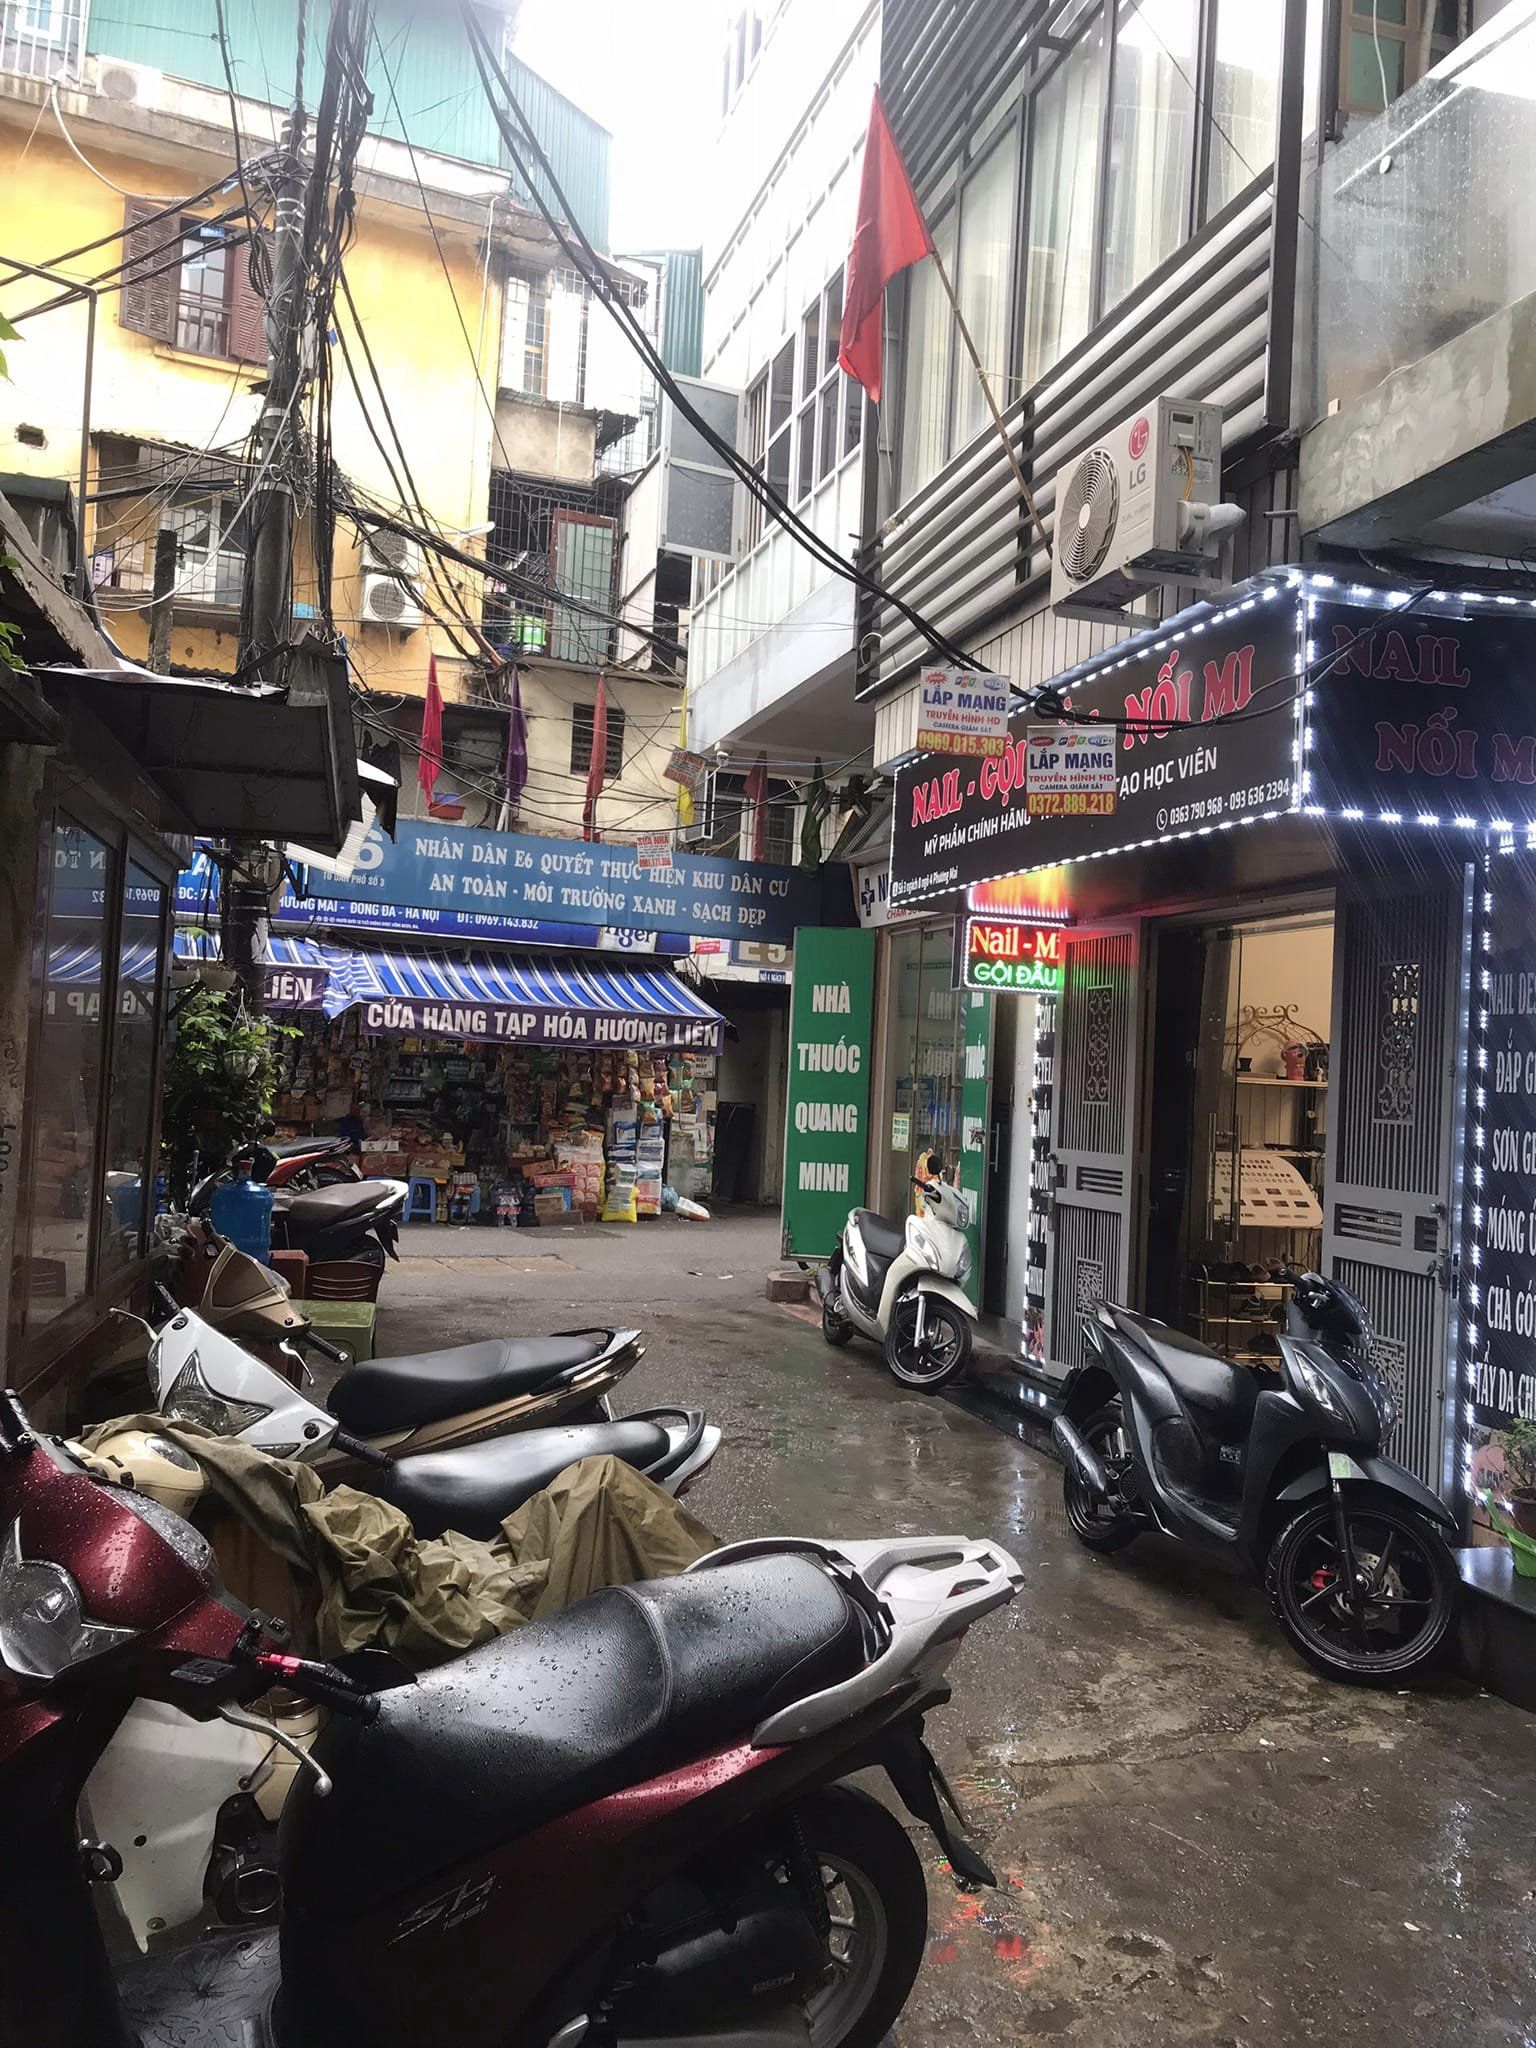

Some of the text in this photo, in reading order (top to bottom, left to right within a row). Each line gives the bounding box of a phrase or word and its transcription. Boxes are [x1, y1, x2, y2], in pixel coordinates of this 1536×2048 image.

[1129, 463, 1146, 490] LG
[1331, 624, 1471, 688] NAIL
[923, 685, 1006, 712] LẮP MẠNG
[911, 768, 964, 828] NAIL
[979, 732, 1028, 806] GỘI
[1122, 650, 1193, 750] NỐI
[1201, 644, 1255, 722] MI
[933, 721, 959, 730] CAMERA
[988, 716, 1000, 726] HD
[918, 732, 1005, 756] 0969.015.303
[1030, 748, 1113, 772] LẮP MẠNG
[1374, 706, 1536, 785] NỐI M
[1070, 773, 1096, 782] HÌNH
[1099, 774, 1114, 782] HD
[938, 821, 966, 852] PHẨM
[967, 815, 999, 843] CHÍNH
[1117, 771, 1140, 801] ẠO
[1143, 760, 1174, 790] HỌC
[1177, 746, 1217, 780] VIÊN
[1028, 793, 1114, 814] 0372.889.218
[1170, 807, 1189, 825] 0363
[1190, 802, 1205, 821] 790
[1206, 797, 1223, 817] 968
[1229, 792, 1246, 810] 093
[1247, 787, 1264, 806] 636
[1265, 778, 1290, 802] 2394
[379, 879, 385, 888] 3
[415, 837, 464, 861] NHÂN
[472, 842, 507, 866] DÂN
[515, 849, 533, 869] E6
[541, 851, 594, 876] QUYẾT
[601, 859, 642, 884] THỰC
[692, 870, 725, 890] KHU
[730, 873, 763, 895] DÂN
[769, 878, 790, 897] CƯ
[317, 900, 338, 913] MAI
[429, 873, 455, 892] AN
[462, 874, 507, 898] TOÀN
[524, 880, 554, 903] MÔI
[561, 885, 626, 911] TRƯỜNG
[632, 895, 676, 916] XANH
[692, 901, 732, 924] SẠCH
[738, 906, 766, 928] ĐẸP
[970, 926, 1019, 956] Nail
[1034, 931, 1061, 959] M
[974, 960, 1058, 986] GỘI ĐẦU
[812, 980, 850, 1013] NHÀ
[1488, 973, 1514, 1015] NAIL
[368, 998, 718, 1047] CỬA HÀNG TẠP HÓA HƯƠNG LIÊN
[797, 1034, 861, 1073] THUỐC
[1496, 1028, 1522, 1093] ĐẮP
[795, 1102, 857, 1133] QUANG
[1492, 1127, 1519, 1172] SƠN
[799, 1162, 849, 1193] MINH
[1487, 1195, 1525, 1254] MÓNG
[1487, 1275, 1512, 1332] CHÀ
[1476, 1340, 1536, 1420] TẨY DA CH
